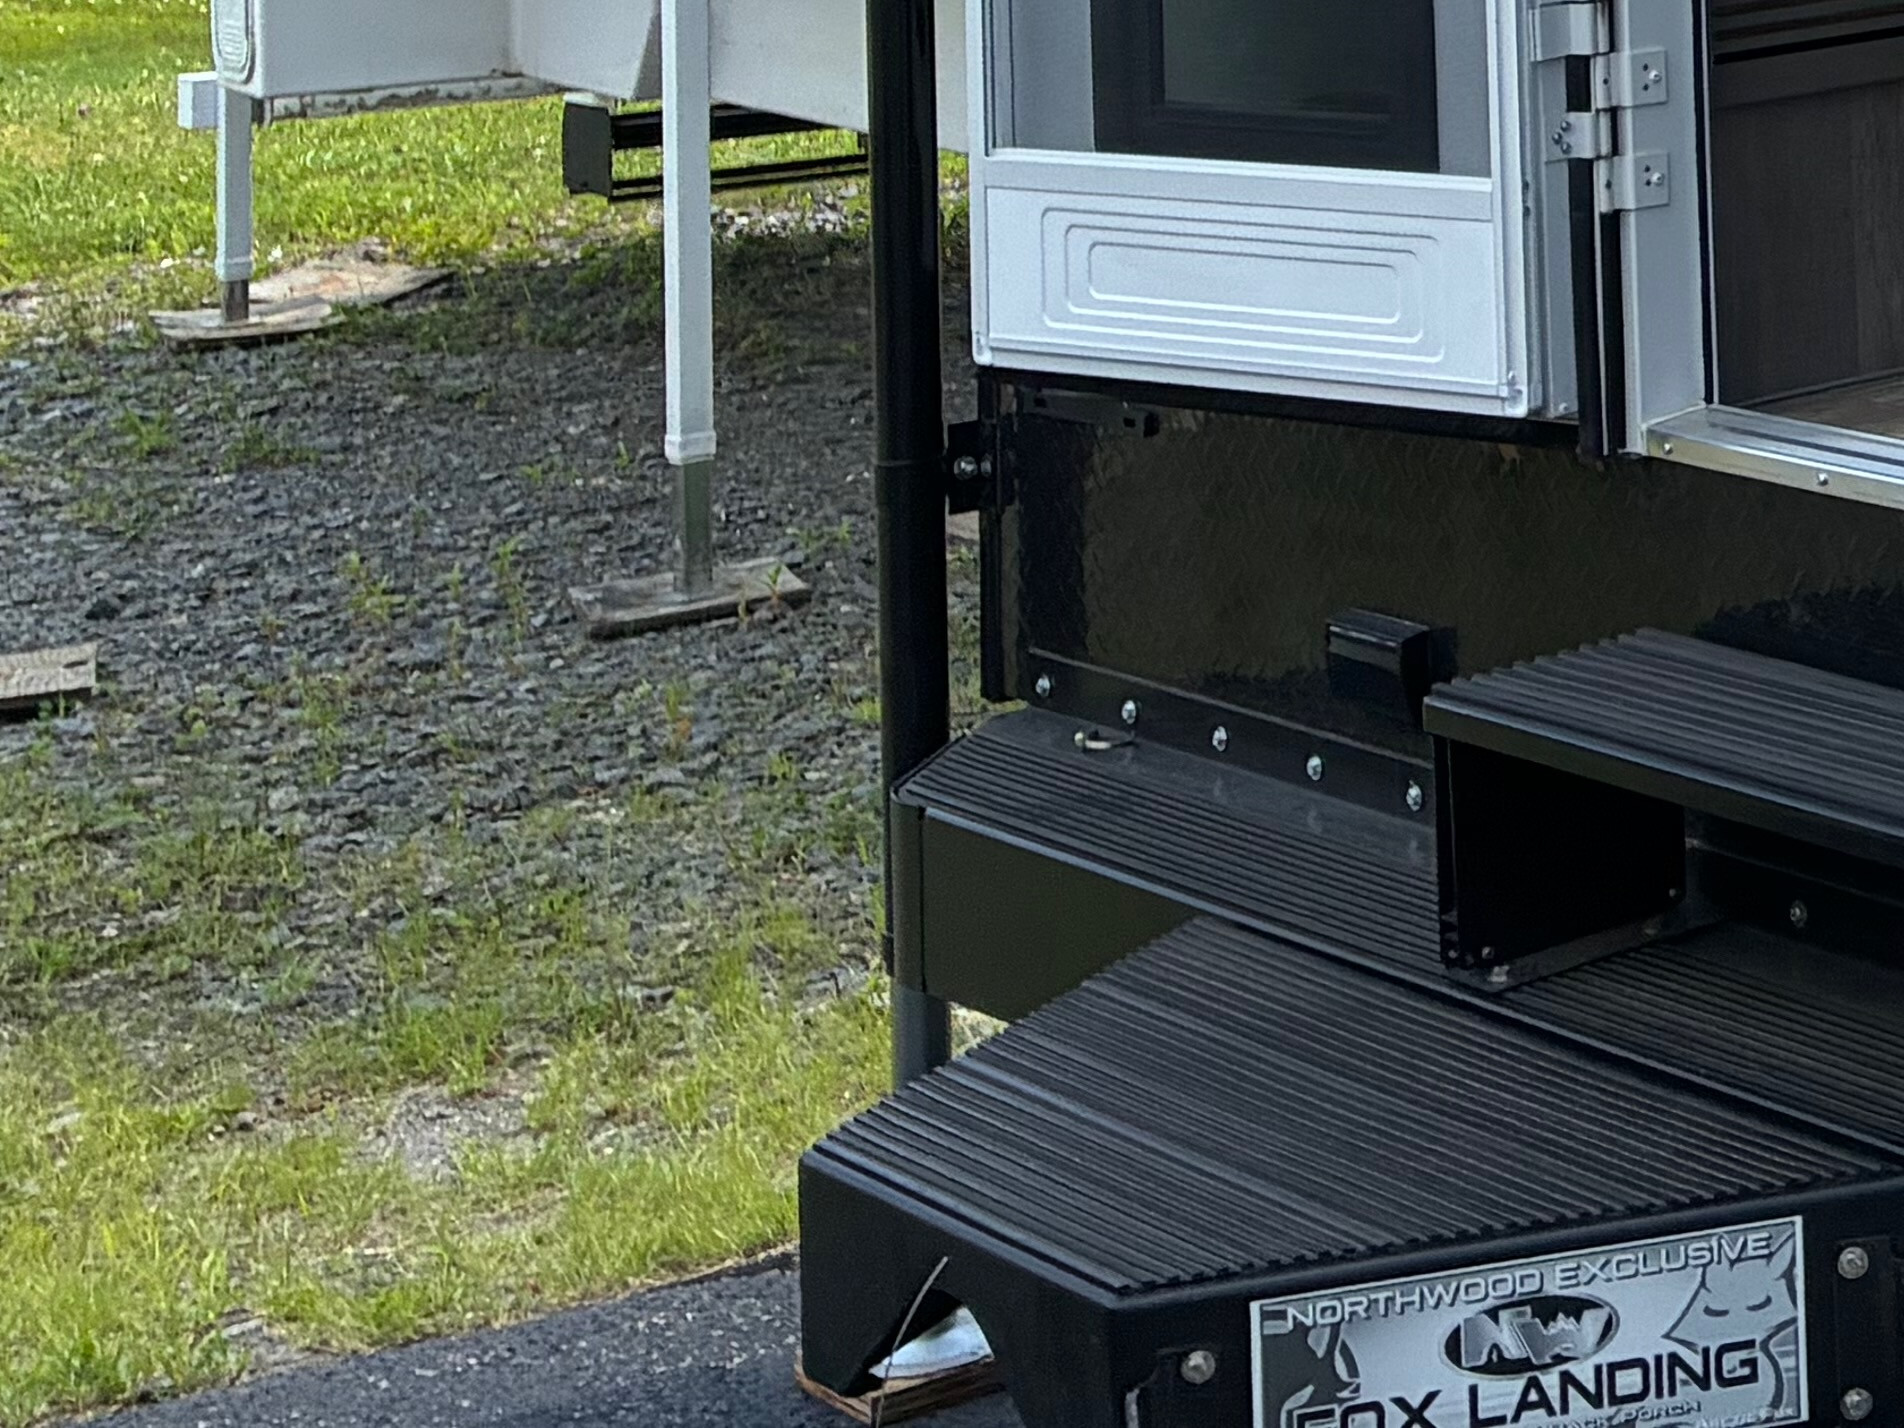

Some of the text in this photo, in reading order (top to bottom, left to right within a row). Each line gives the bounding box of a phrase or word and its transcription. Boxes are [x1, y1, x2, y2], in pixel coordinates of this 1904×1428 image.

[1285, 1230, 1772, 1330] NORTHWOOD EXCLUSIVE
[1468, 1338, 1761, 1428] LANDING
